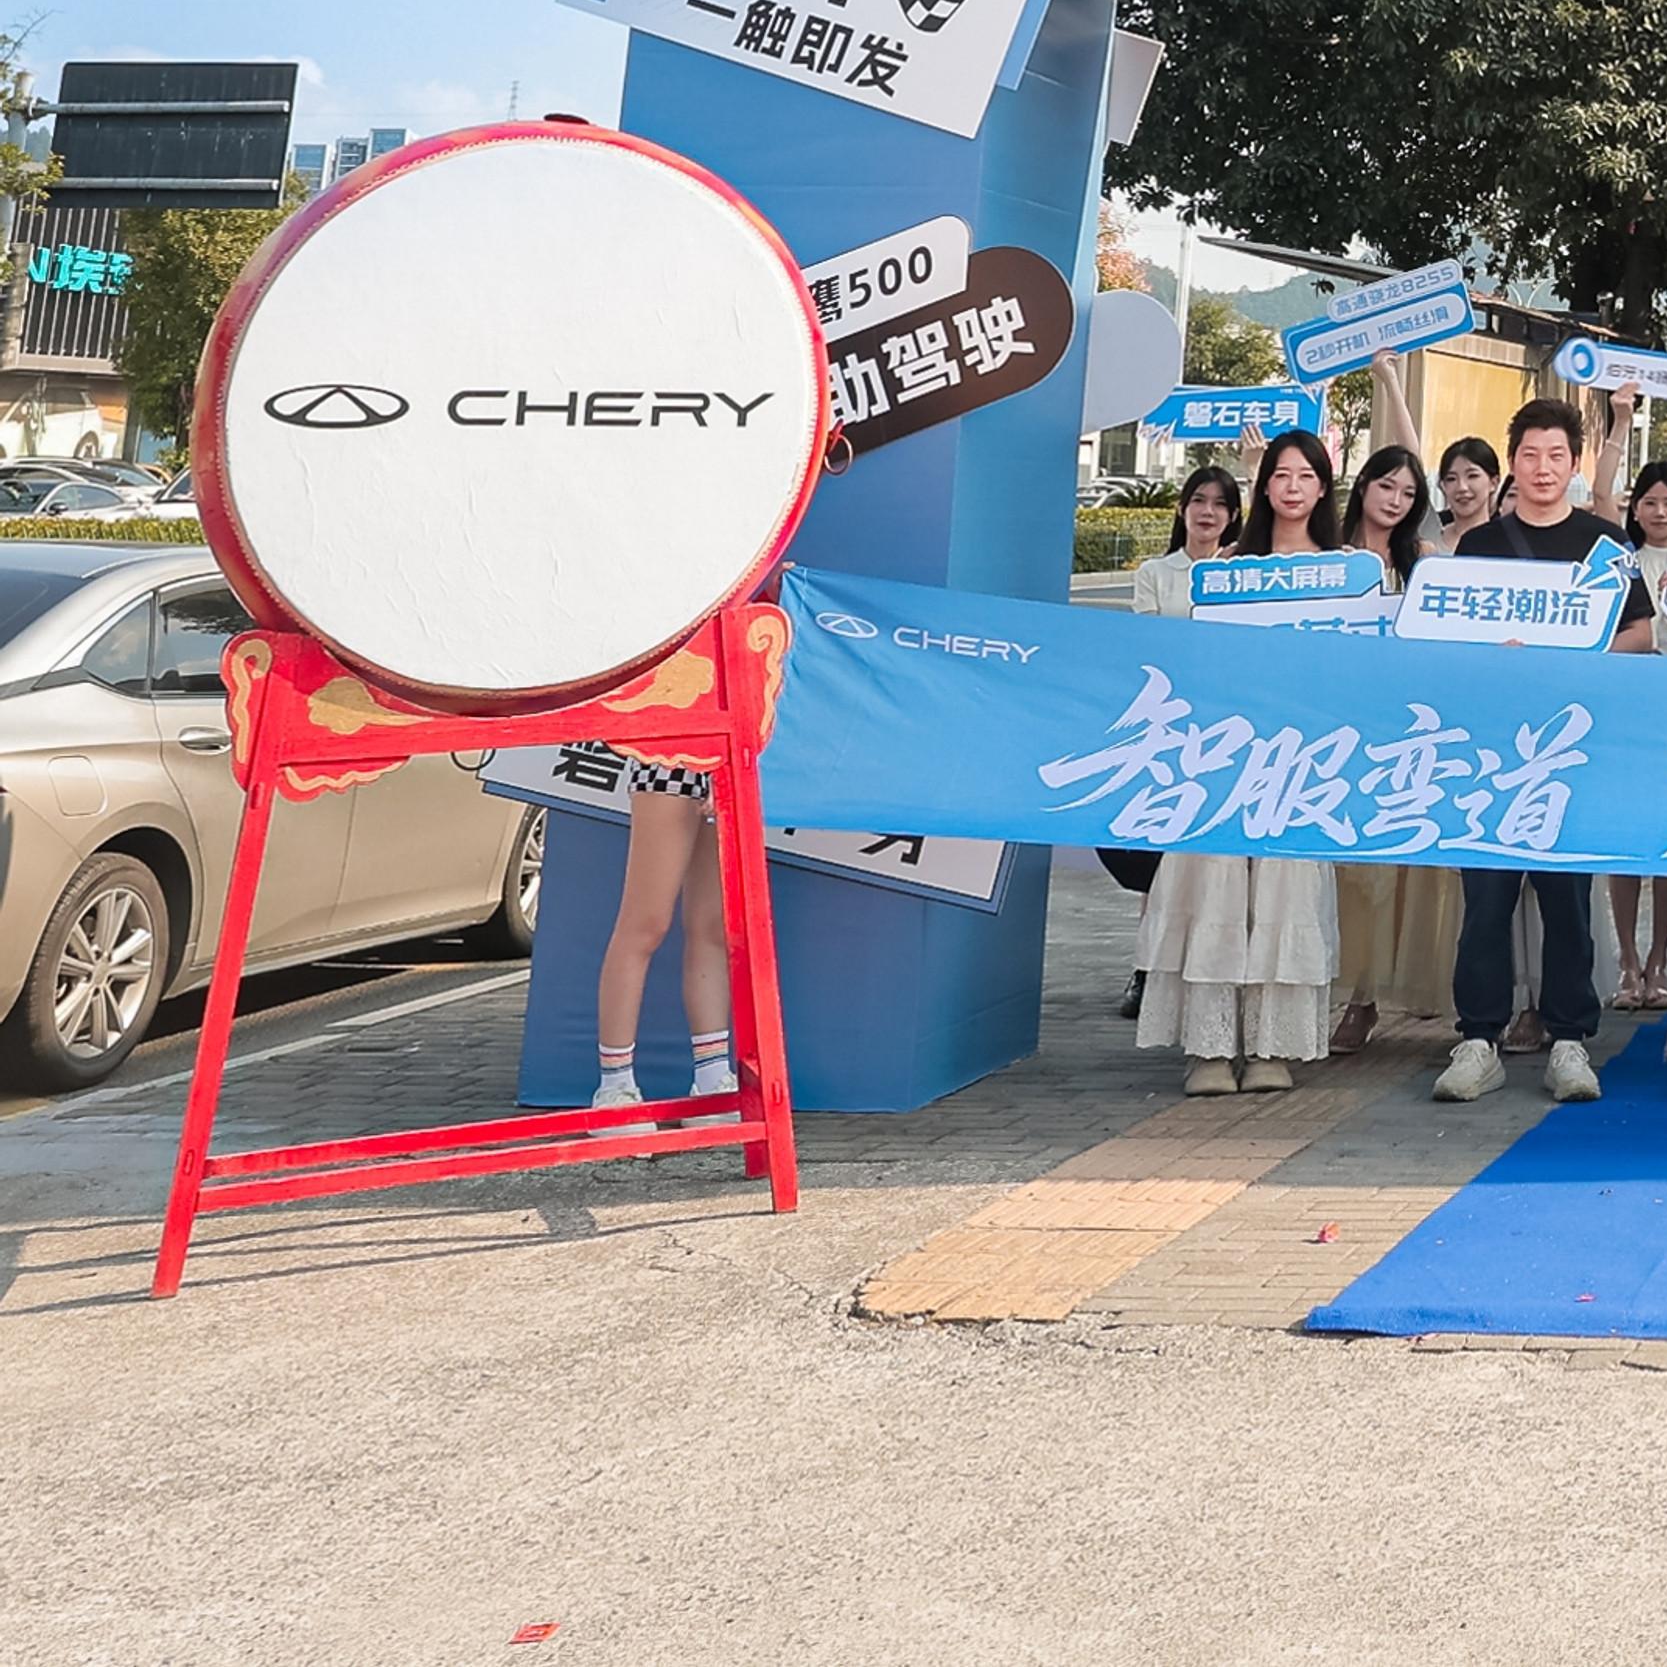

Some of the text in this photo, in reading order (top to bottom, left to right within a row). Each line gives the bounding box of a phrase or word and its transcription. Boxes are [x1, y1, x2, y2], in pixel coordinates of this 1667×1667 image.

[1305, 331, 1370, 365] 2秒开机
[447, 389, 775, 428] CHERY
[1183, 400, 1299, 428] 磐石车身
[1202, 563, 1347, 594] 高清大屏幕
[1419, 583, 1591, 626] 年轻潮流
[892, 627, 1041, 665] CHERY
[1039, 665, 1648, 862] 智服弯道
